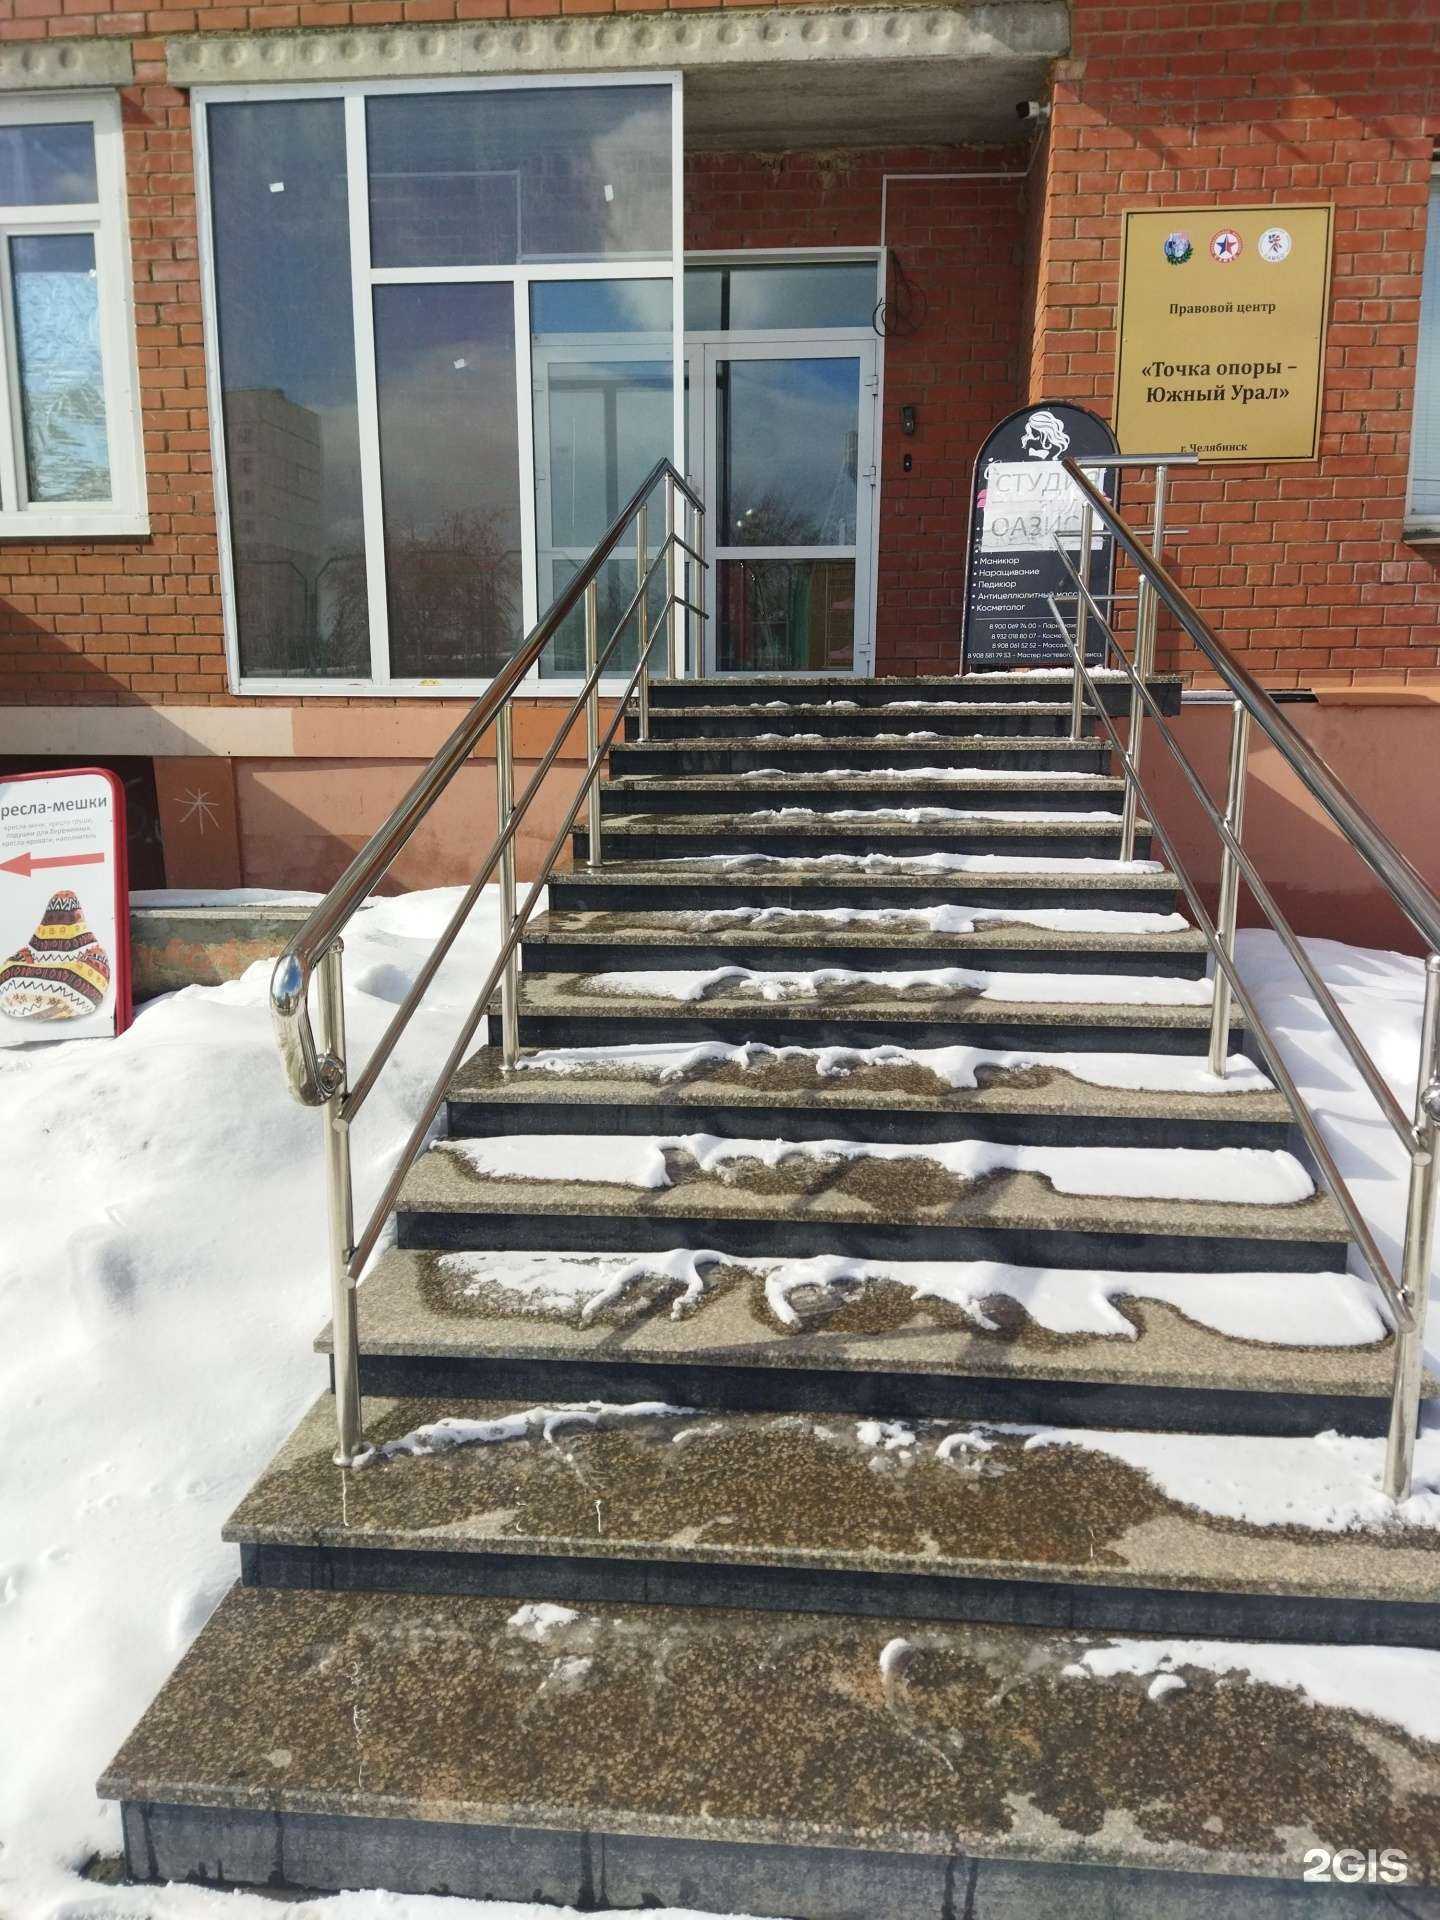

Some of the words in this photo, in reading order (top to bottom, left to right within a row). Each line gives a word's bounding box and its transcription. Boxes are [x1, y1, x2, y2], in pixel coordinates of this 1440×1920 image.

[1169, 302, 1233, 316] Правовой
[1236, 302, 1276, 315] центр
[1142, 361, 1211, 378] «Точка
[1216, 362, 1282, 379] опоры
[1146, 385, 1226, 403] Южный
[1231, 385, 1289, 405] Урал»
[1190, 443, 1248, 452] Челябинск
[980, 557, 1020, 565] Маникюр
[979, 568, 1040, 577] Наращивание
[978, 581, 1017, 589] Педикюр
[0, 797, 107, 820] ресла-мешки
